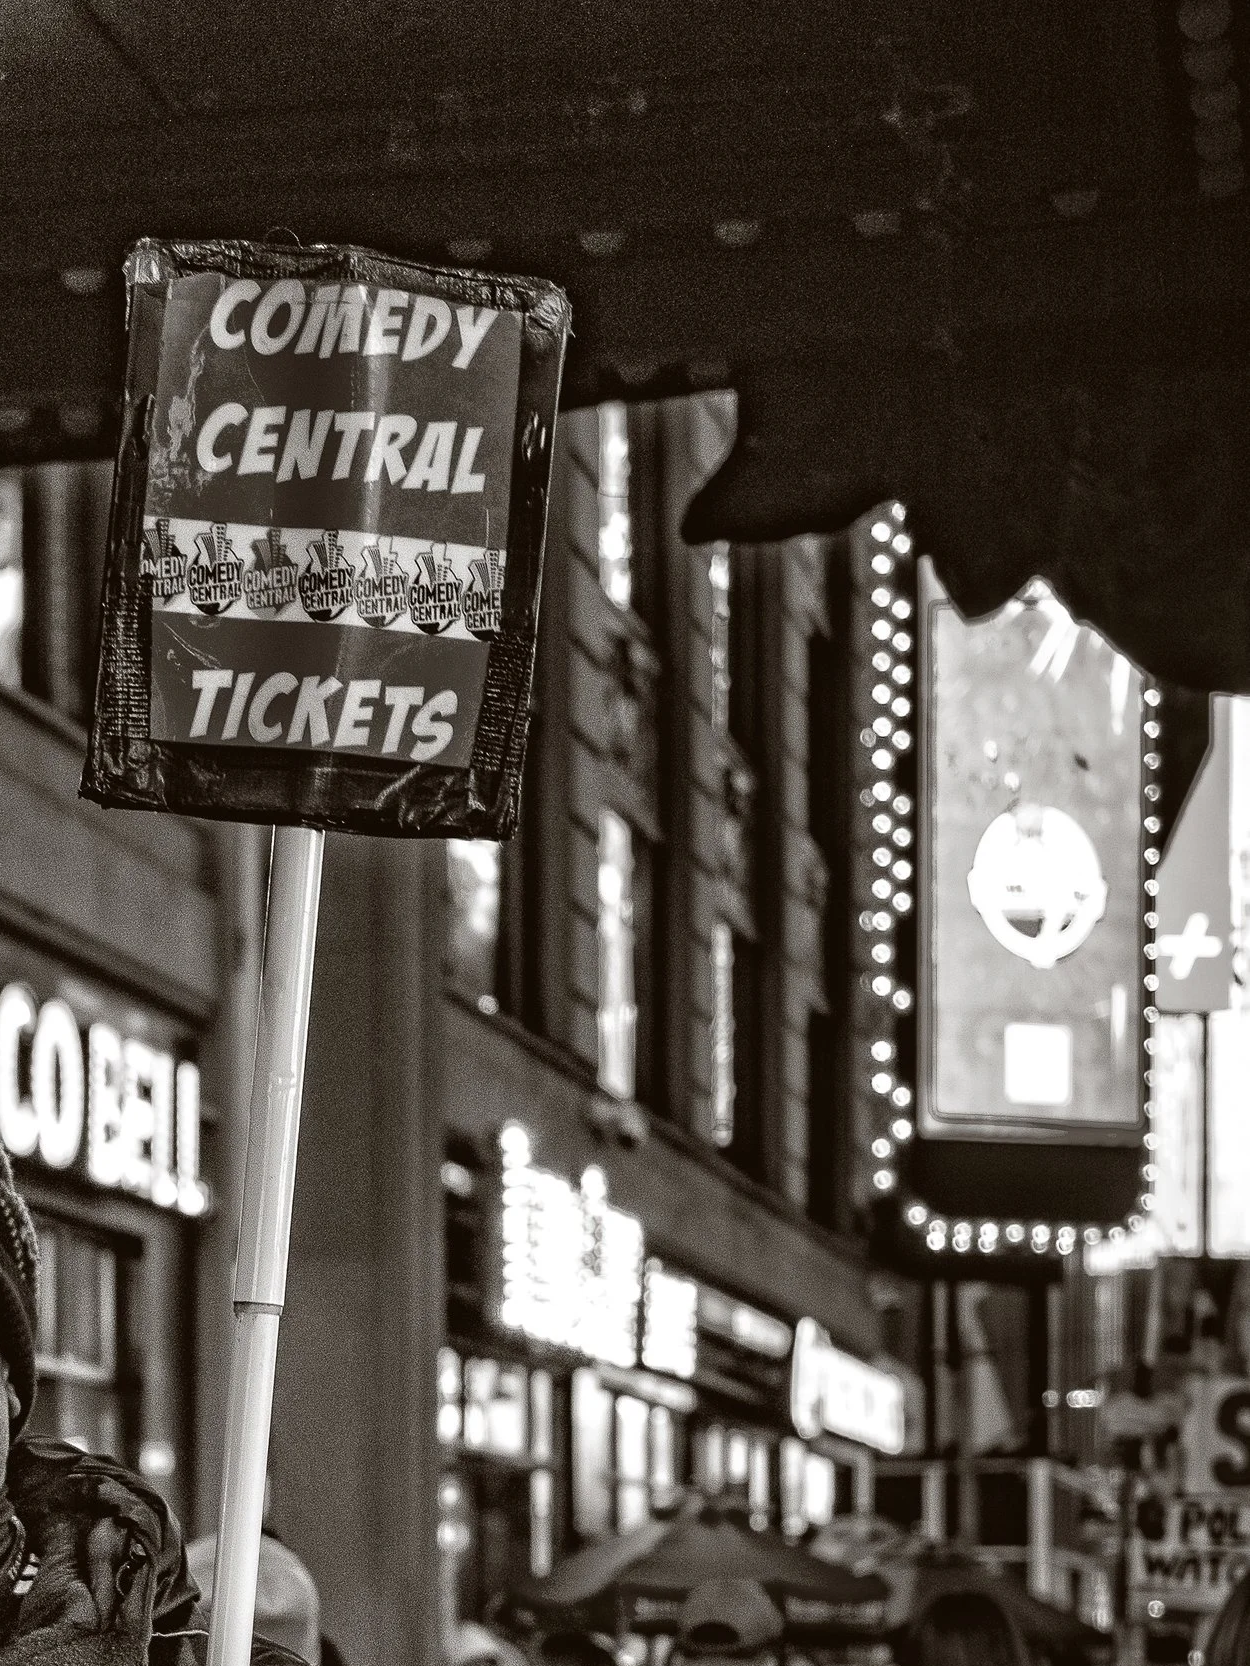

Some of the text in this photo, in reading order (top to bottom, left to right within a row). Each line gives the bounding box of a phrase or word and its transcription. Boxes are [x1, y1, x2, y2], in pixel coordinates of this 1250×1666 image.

[210, 279, 499, 370] COMEDY
[197, 402, 486, 495] CENTRAL
[141, 555, 187, 579] OMEDY
[190, 562, 244, 586] COMEDY
[245, 566, 298, 591] COMEDY
[301, 567, 354, 593] COMEDY
[356, 575, 408, 599] COMEDY
[192, 584, 242, 602] CENTRAL
[247, 589, 296, 609] CENTRAL
[303, 589, 352, 611] CENTRAL
[410, 581, 462, 607] COMEDY
[464, 589, 500, 613] COME
[358, 596, 406, 615] CENTRAL
[412, 604, 460, 622] CENTRAL
[189, 670, 459, 762] TICKETS
